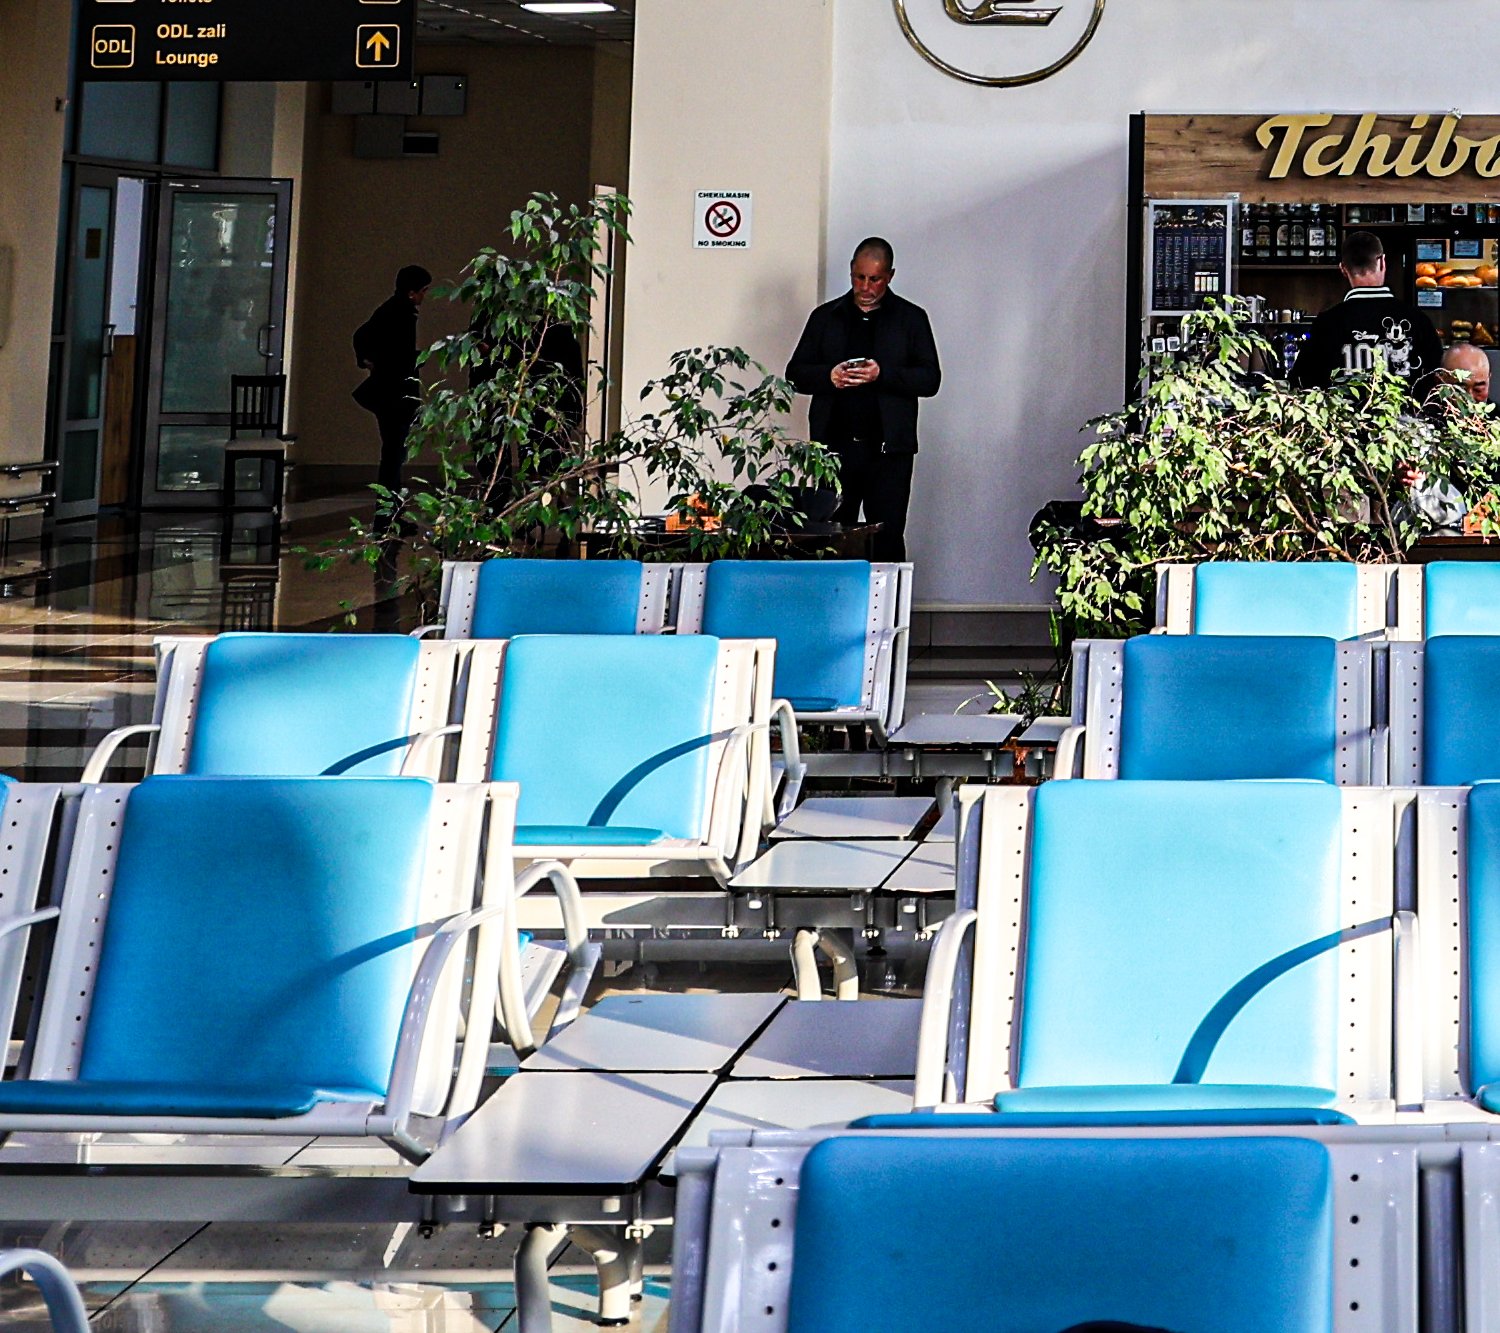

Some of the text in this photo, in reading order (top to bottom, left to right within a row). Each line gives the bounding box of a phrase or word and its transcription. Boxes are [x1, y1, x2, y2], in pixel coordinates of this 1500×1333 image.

[156, 23, 226, 38] ODL zali
[94, 39, 131, 53] ODL
[155, 50, 219, 68] Lounge
